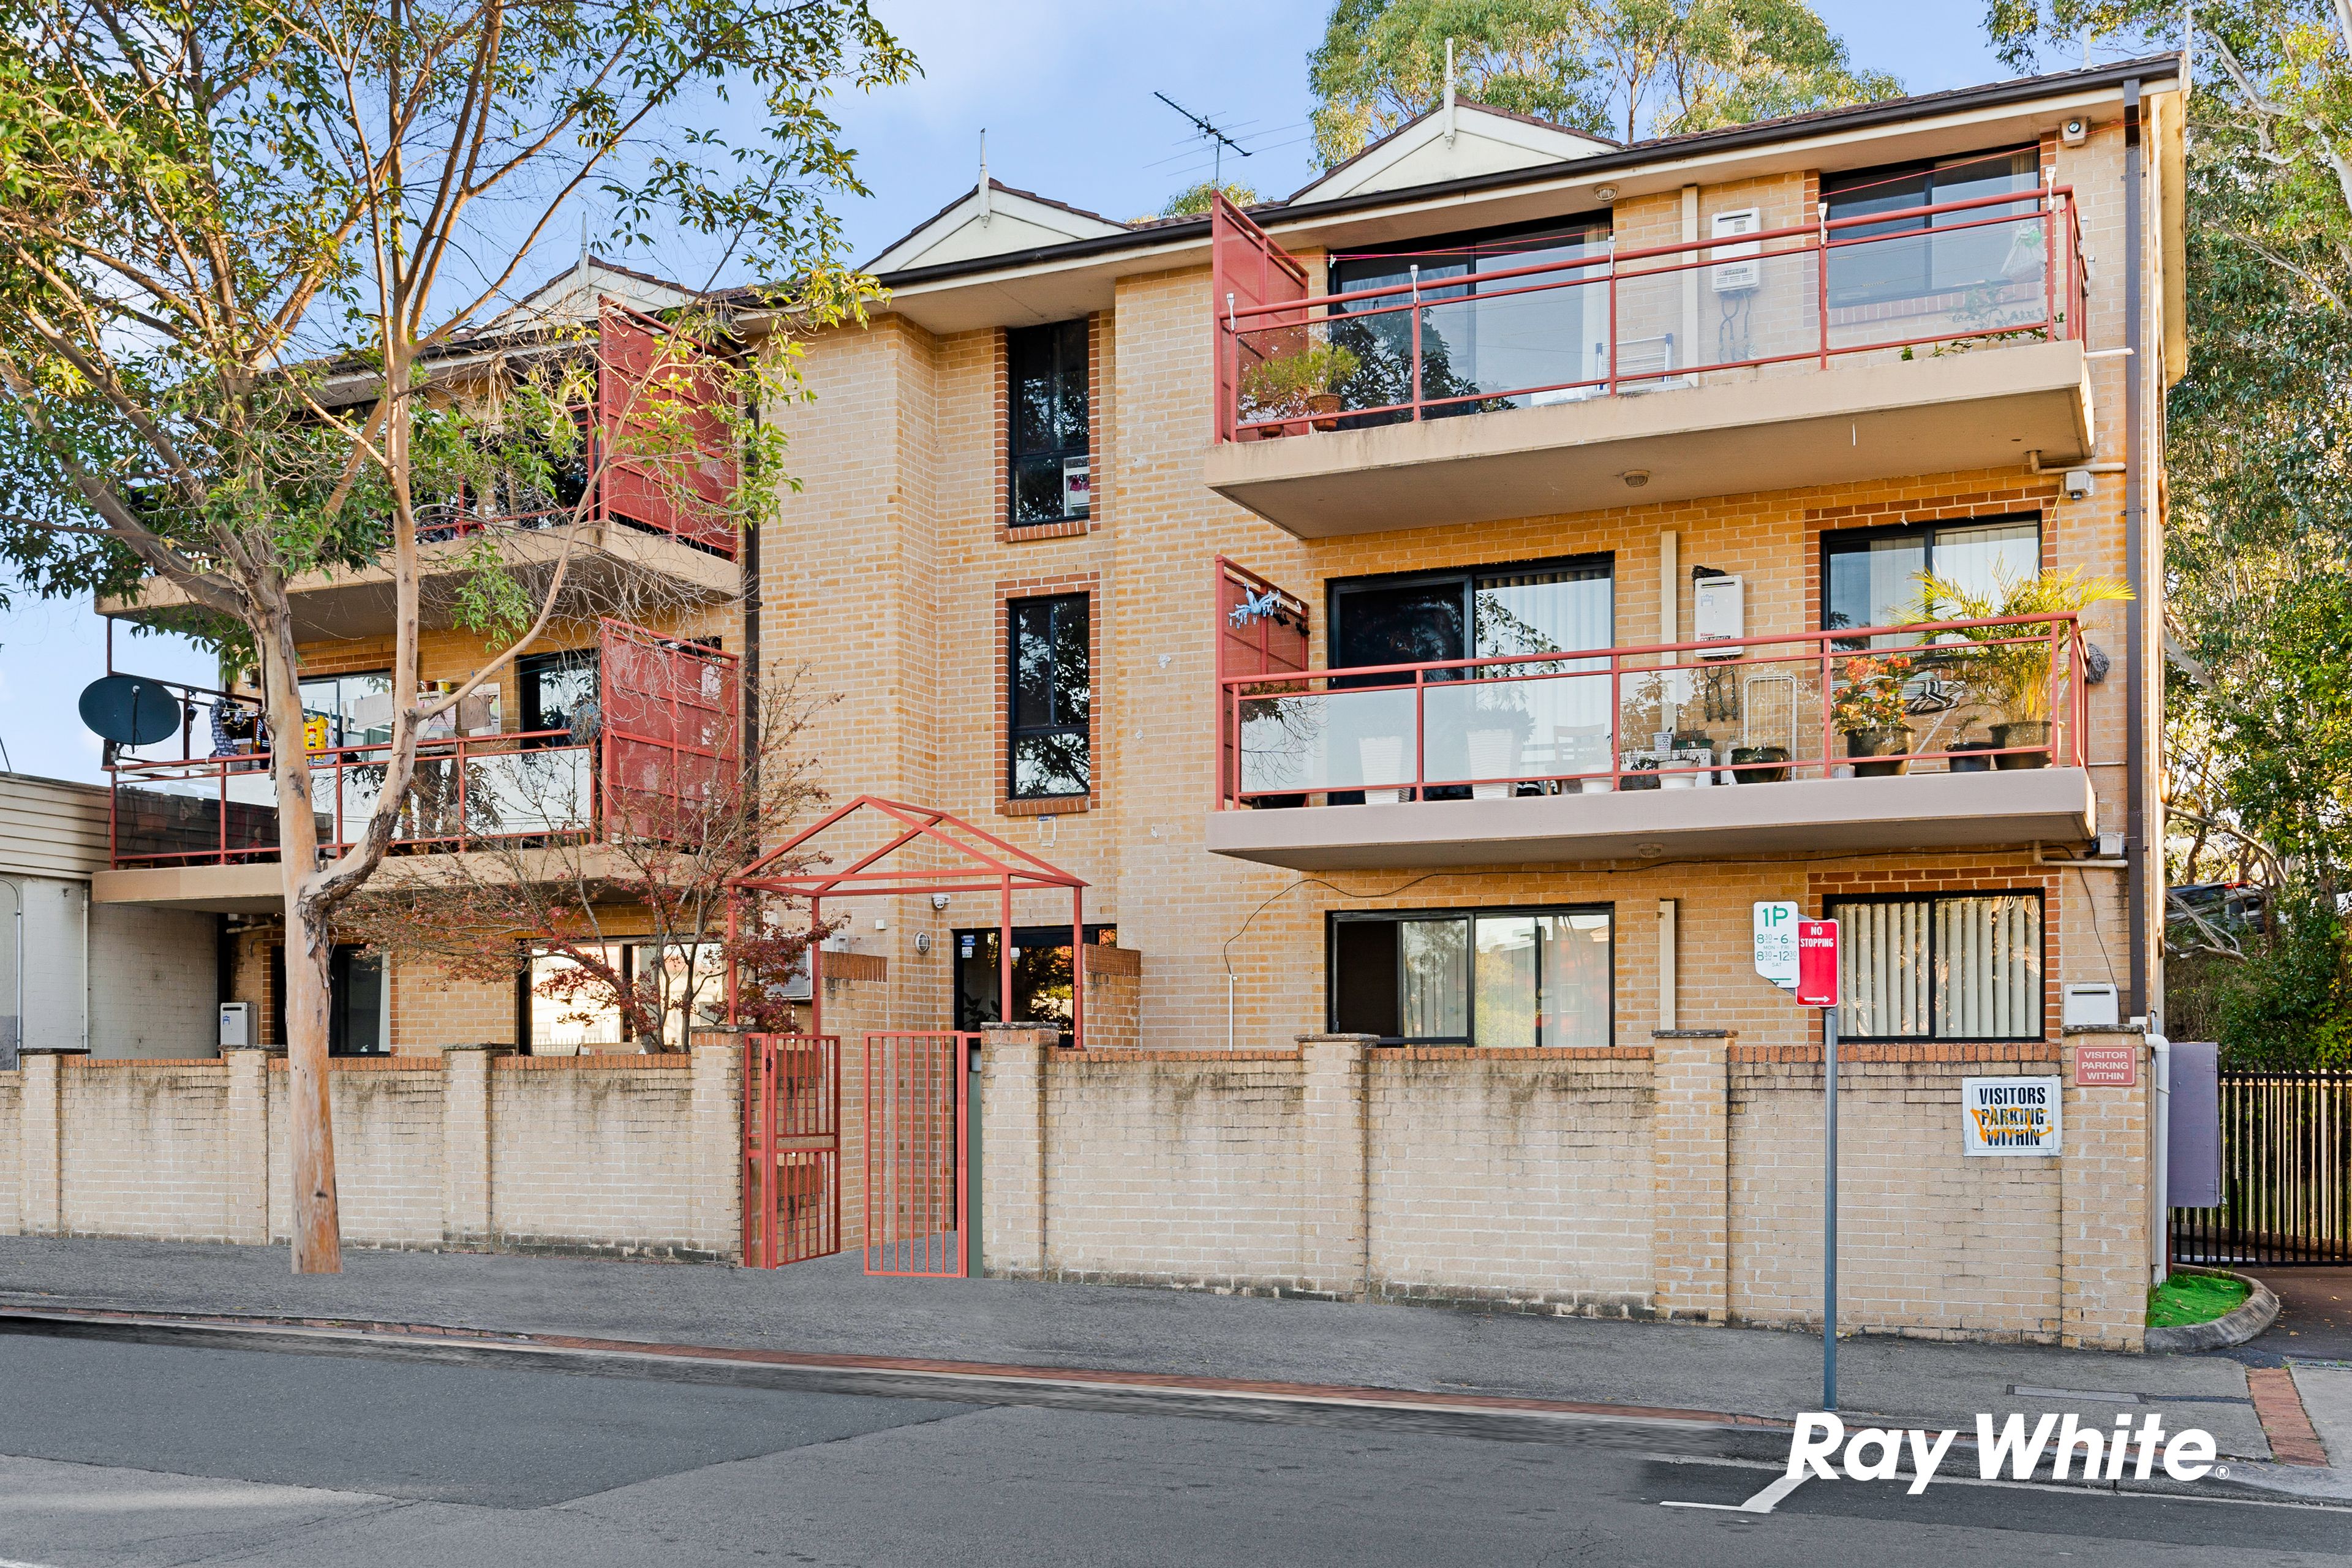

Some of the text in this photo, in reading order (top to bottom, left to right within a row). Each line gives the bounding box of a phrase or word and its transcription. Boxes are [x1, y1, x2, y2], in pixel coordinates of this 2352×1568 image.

[1762, 908, 1789, 927] 1P
[1781, 933, 1789, 944] 6
[1811, 926, 1823, 936] NO
[1800, 938, 1834, 948] STOPPING
[1979, 1087, 2046, 1105] VISITORS
[1981, 1107, 2044, 1126] PARKING
[1986, 1128, 2040, 1147] WITHIN
